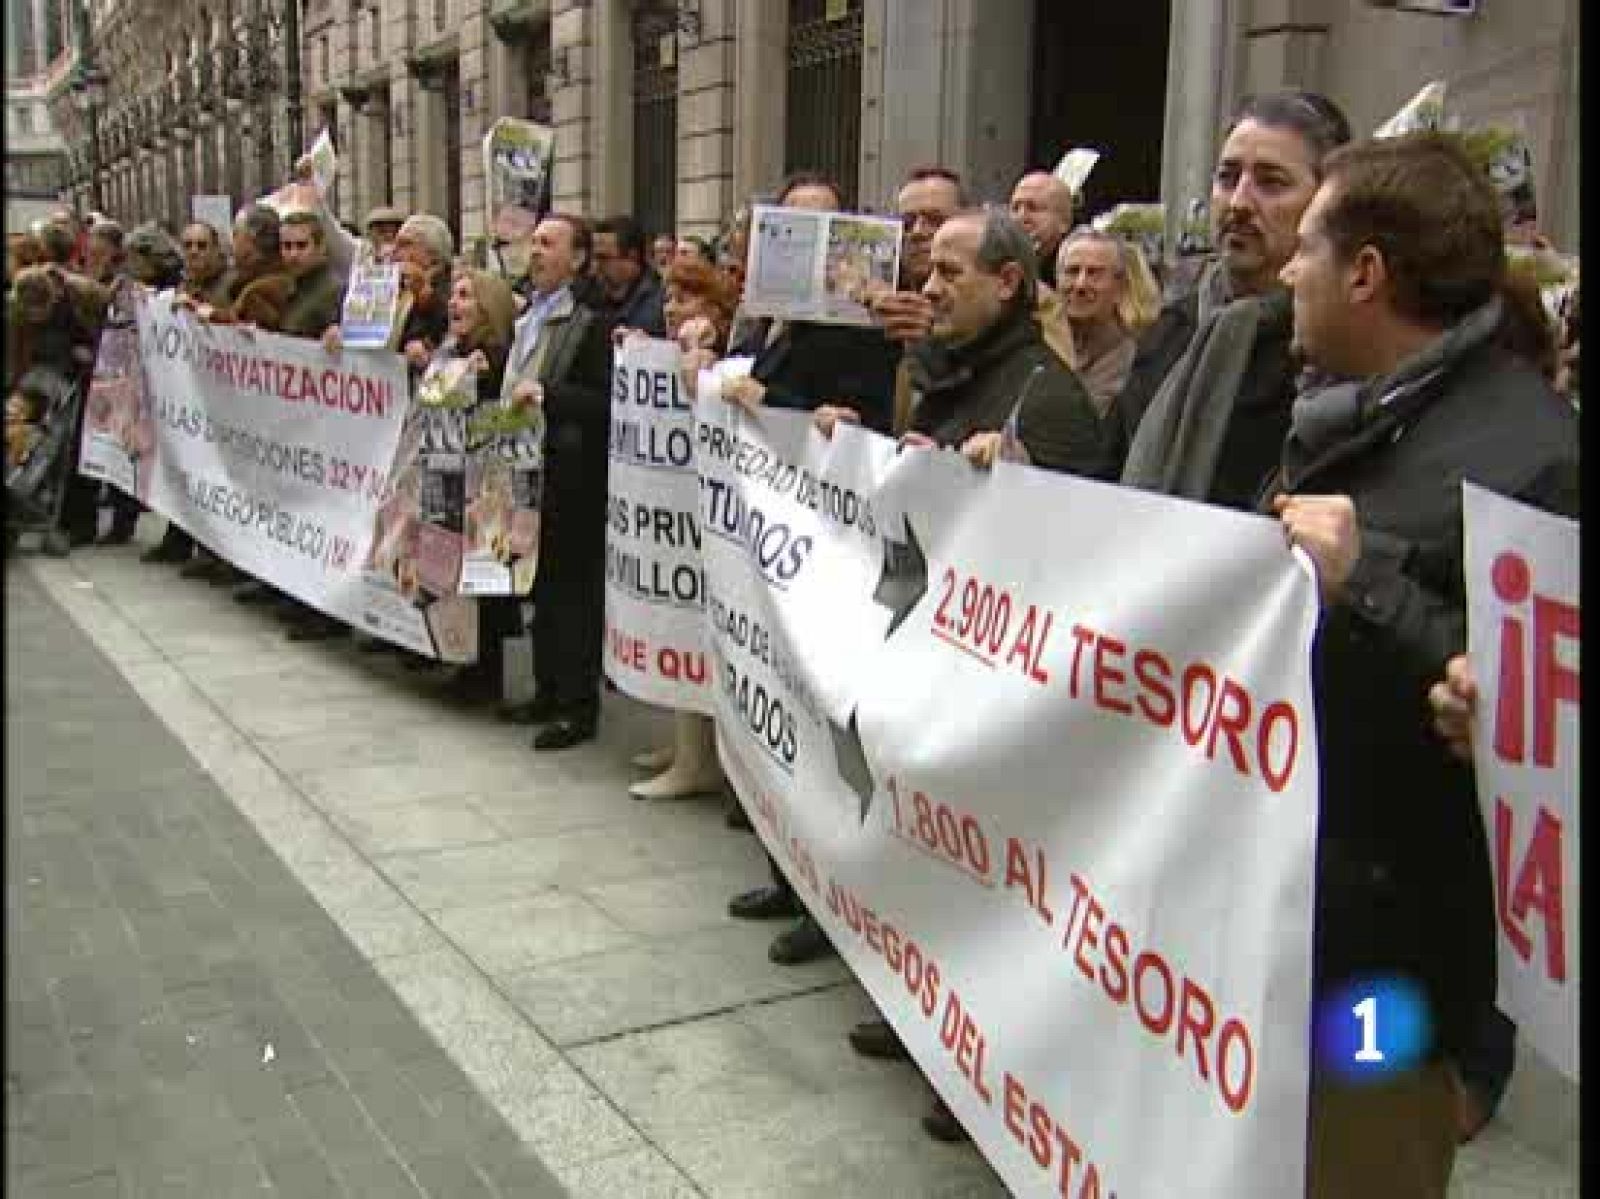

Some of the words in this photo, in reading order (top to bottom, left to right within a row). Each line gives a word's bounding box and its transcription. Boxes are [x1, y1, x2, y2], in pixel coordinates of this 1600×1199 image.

[636, 368, 692, 411] DEL
[611, 495, 629, 536] S
[698, 473, 812, 580] TUIDOS
[604, 620, 647, 673] UE
[658, 647, 706, 684] QU
[934, 566, 1010, 655] 2.900
[1006, 604, 1054, 685] AL
[1068, 622, 1299, 793] TESORO
[886, 774, 991, 875] 1.800
[1005, 836, 1054, 926] AL
[1060, 873, 1255, 1114] TESORO
[1494, 796, 1567, 986] LA
[826, 878, 941, 1018] JUEGOS
[939, 989, 993, 1104] DEL
[1003, 1070, 1118, 1199] ESTA
